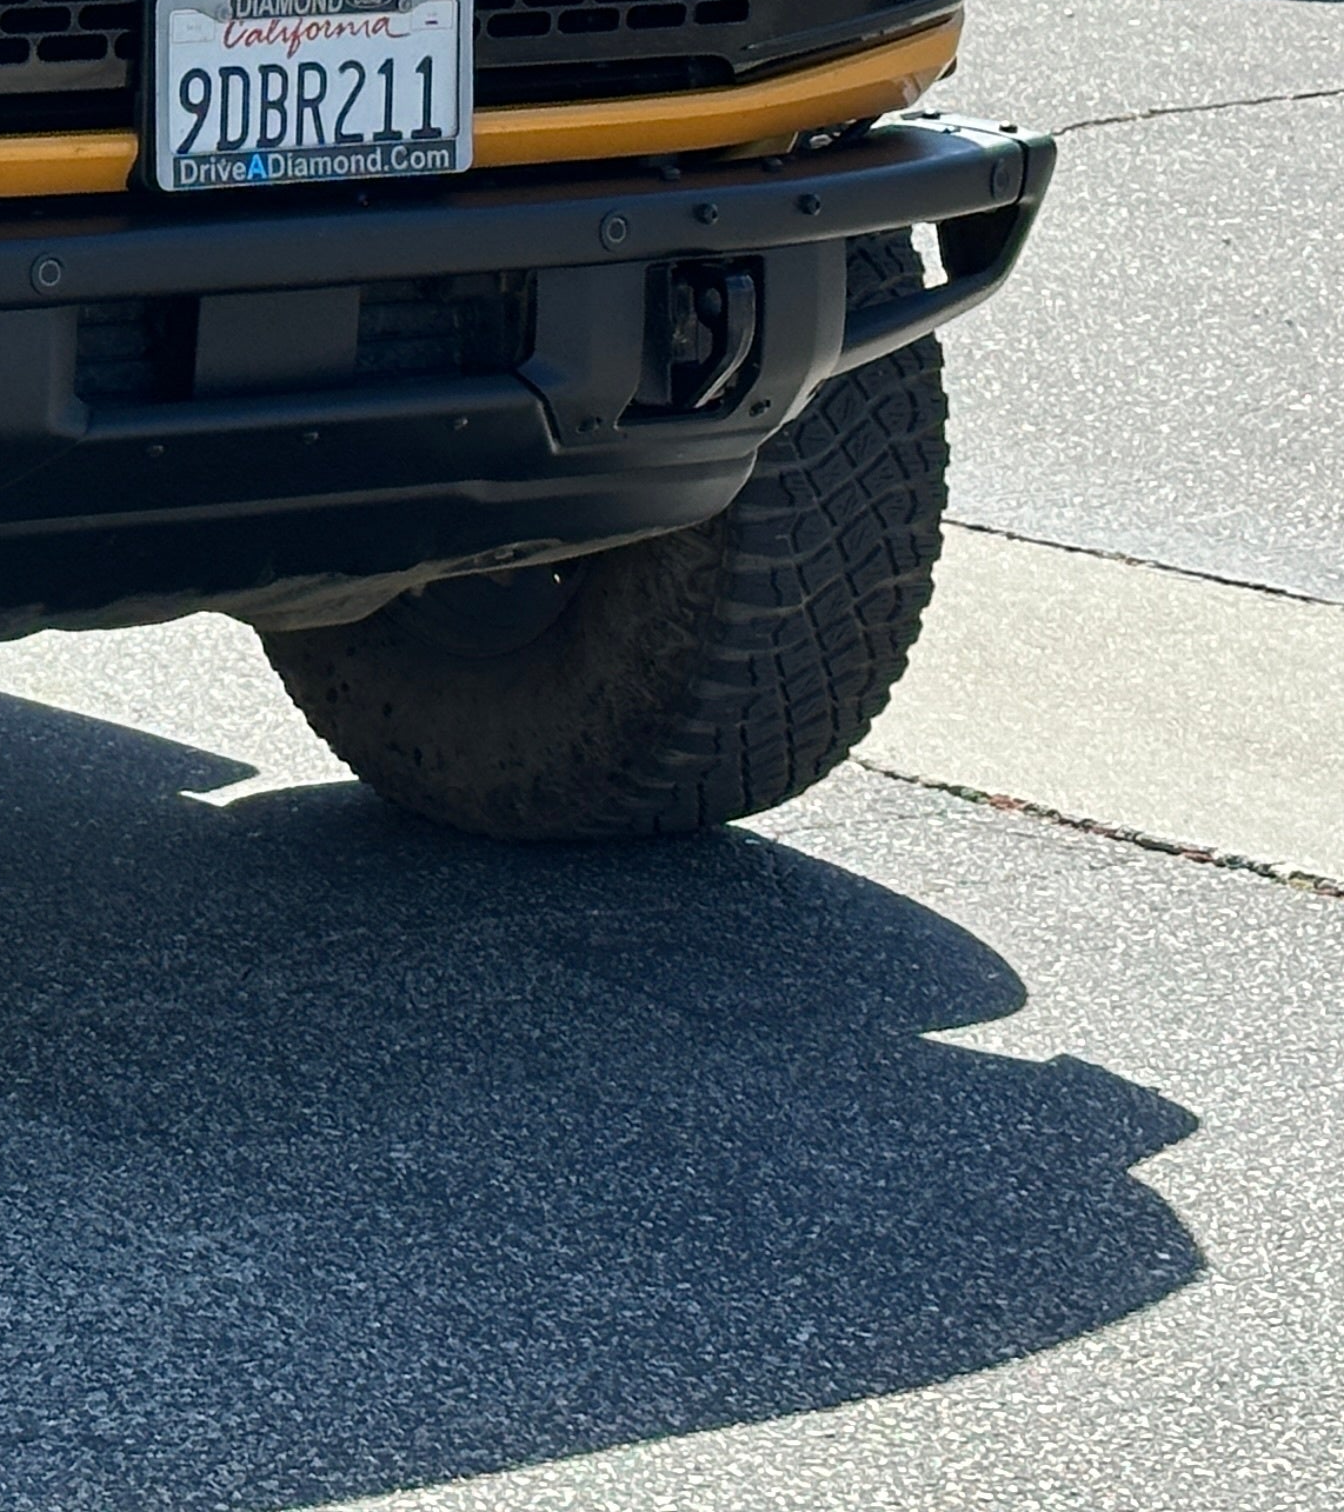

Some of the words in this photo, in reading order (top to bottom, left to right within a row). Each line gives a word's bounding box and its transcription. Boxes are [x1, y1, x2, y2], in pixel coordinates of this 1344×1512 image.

[223, 16, 411, 59] California
[176, 55, 442, 155] 9DBR211
[179, 146, 450, 186] DriveADiamond.Com
